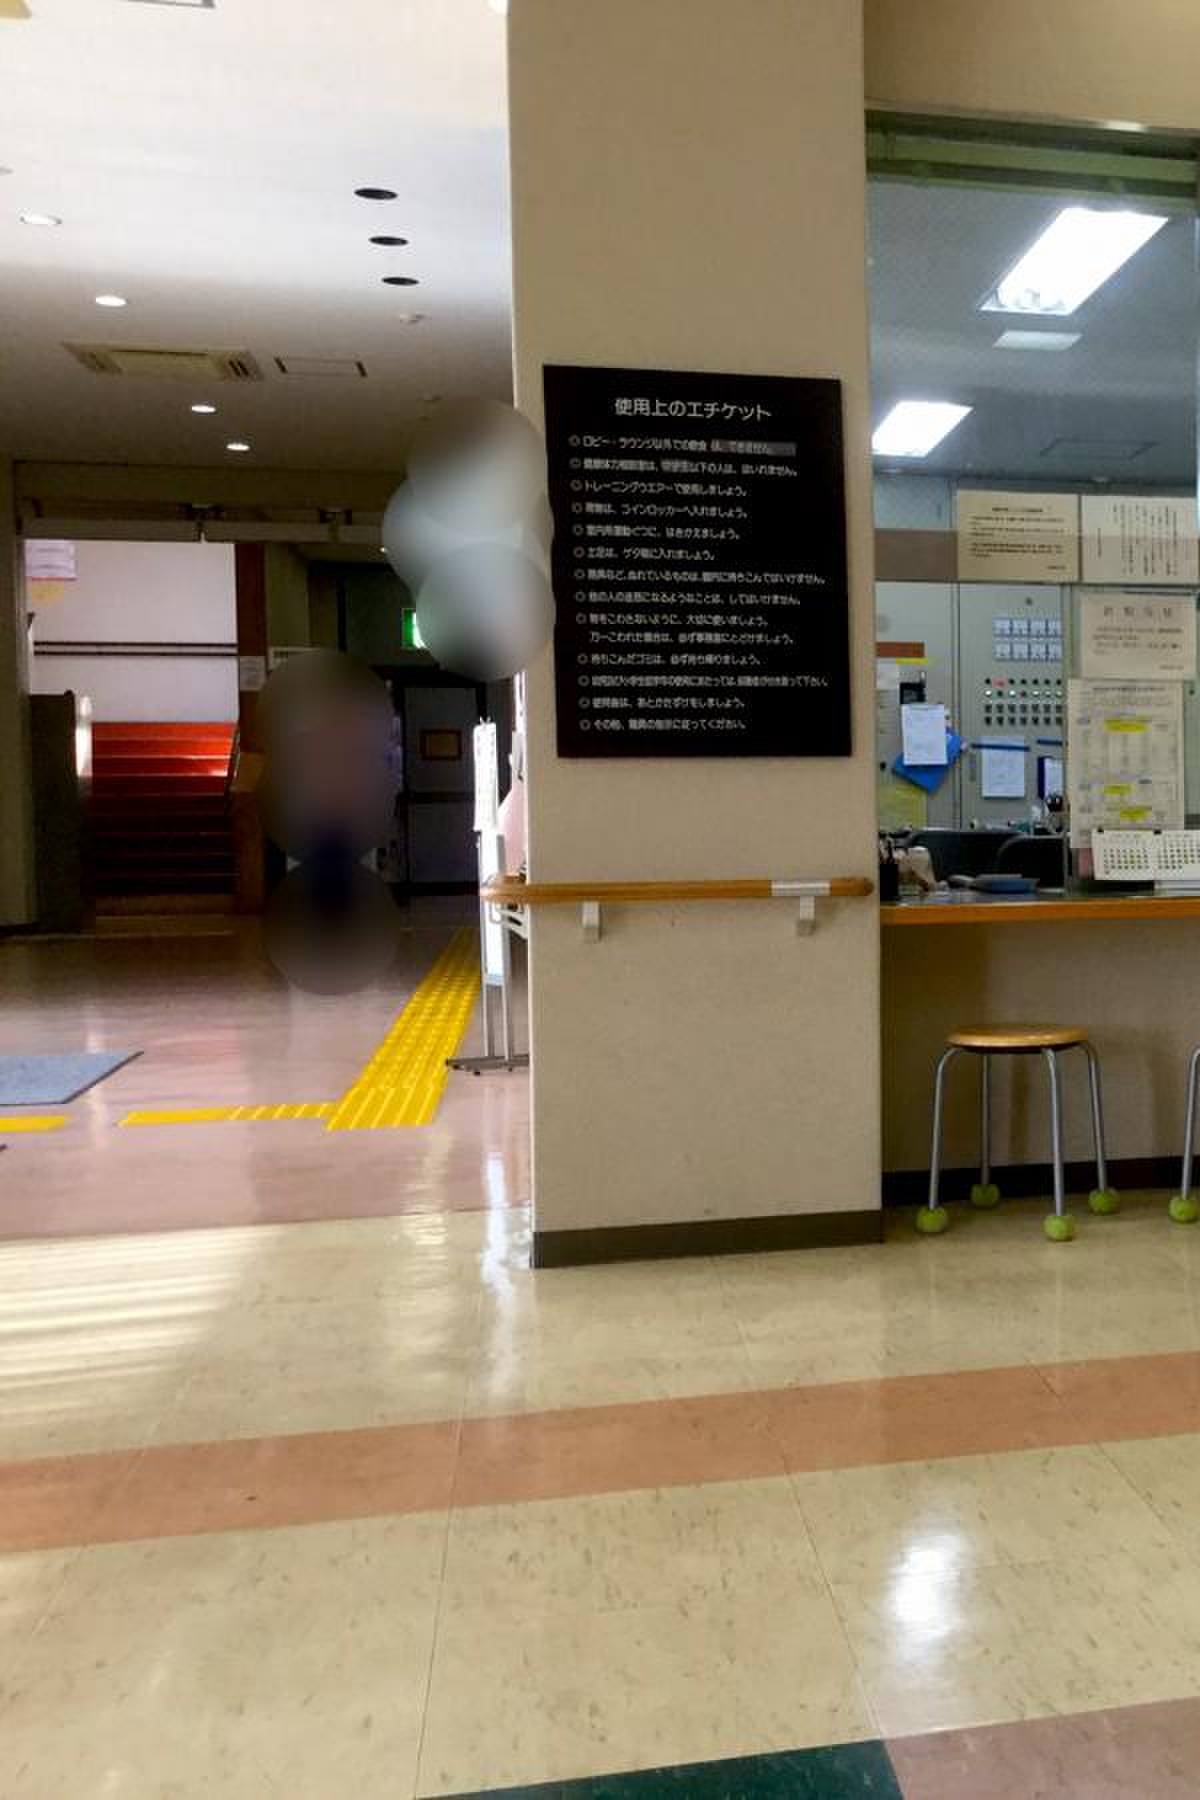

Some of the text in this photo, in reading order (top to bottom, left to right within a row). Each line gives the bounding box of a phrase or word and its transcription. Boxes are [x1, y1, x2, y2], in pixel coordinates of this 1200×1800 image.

[614, 397, 772, 421] 使用上のエチケット
